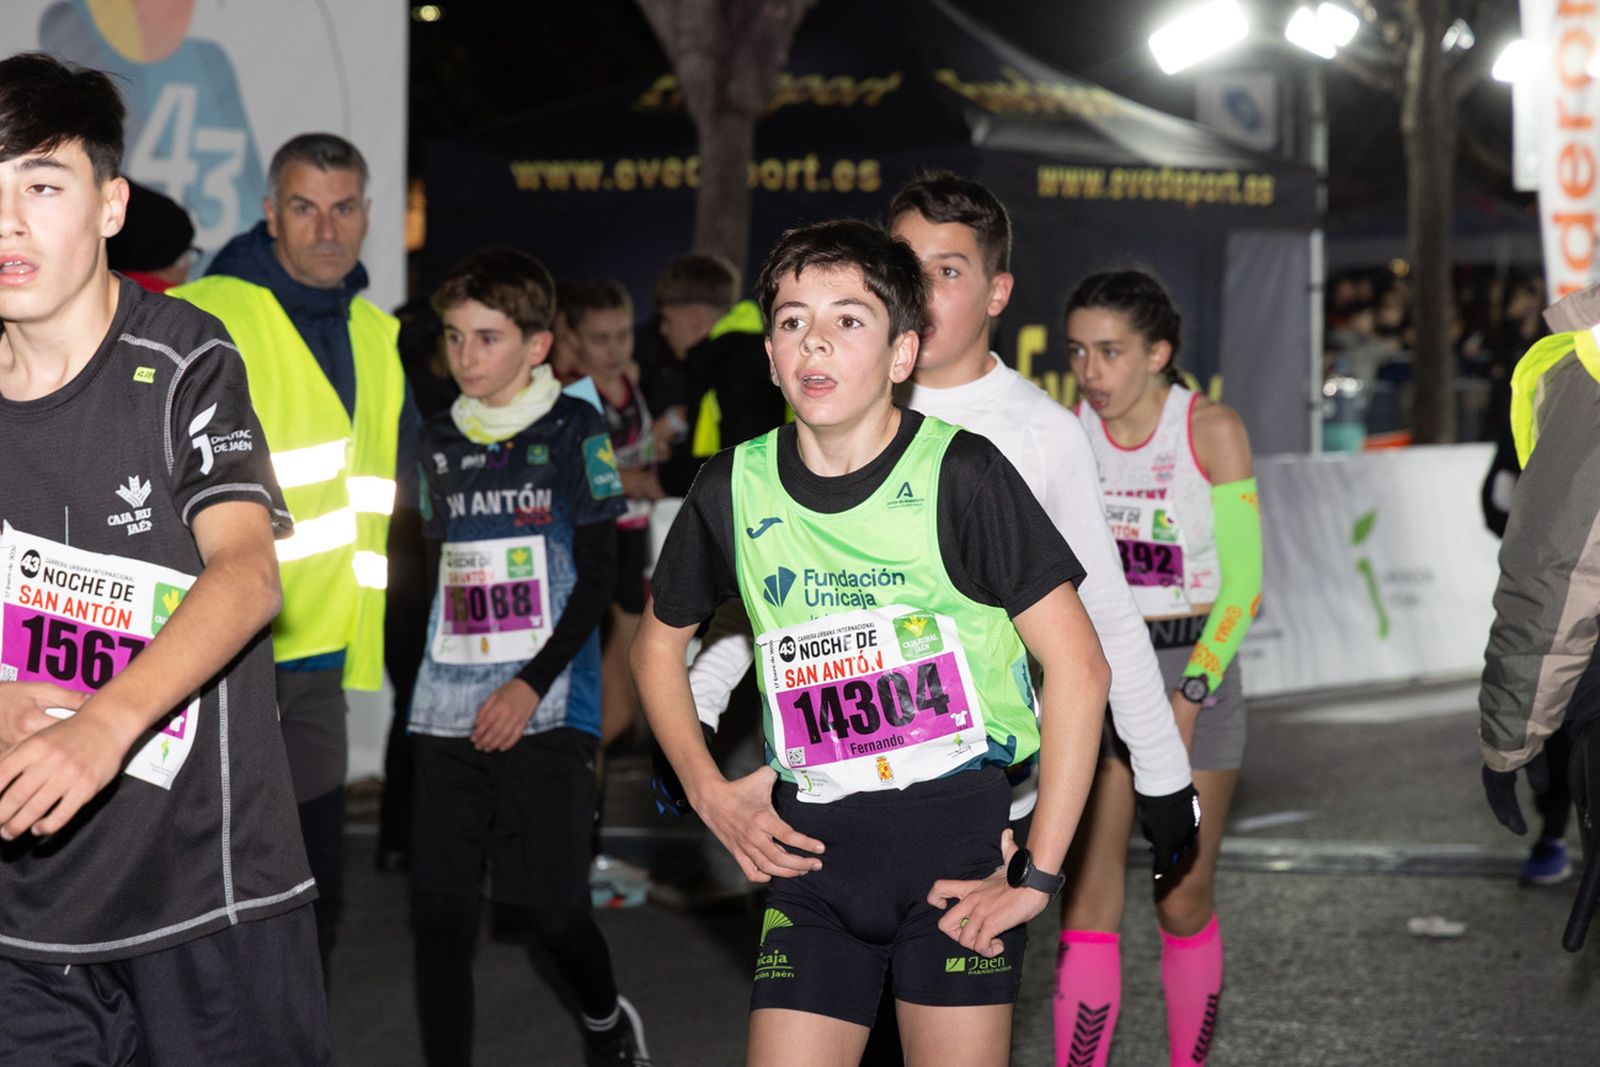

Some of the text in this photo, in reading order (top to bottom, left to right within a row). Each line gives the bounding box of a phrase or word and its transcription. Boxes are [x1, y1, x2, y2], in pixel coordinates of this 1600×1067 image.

[1553, 0, 1597, 297] dero
[130, 83, 247, 250] 43
[471, 482, 552, 516] ANTÓN
[107, 508, 152, 527] CAJA RU
[1116, 540, 1175, 575] 92
[43, 566, 135, 602] NOCHE DE
[804, 567, 906, 587] Fundación
[18, 585, 133, 630] SAN ANTÓN
[804, 588, 877, 610] Unicaja
[21, 614, 146, 690] 1567
[800, 629, 878, 661] NOCHE DE
[785, 649, 884, 689] SAN ANTÓN
[793, 662, 951, 745] 14304
[850, 734, 905, 756] Fernando
